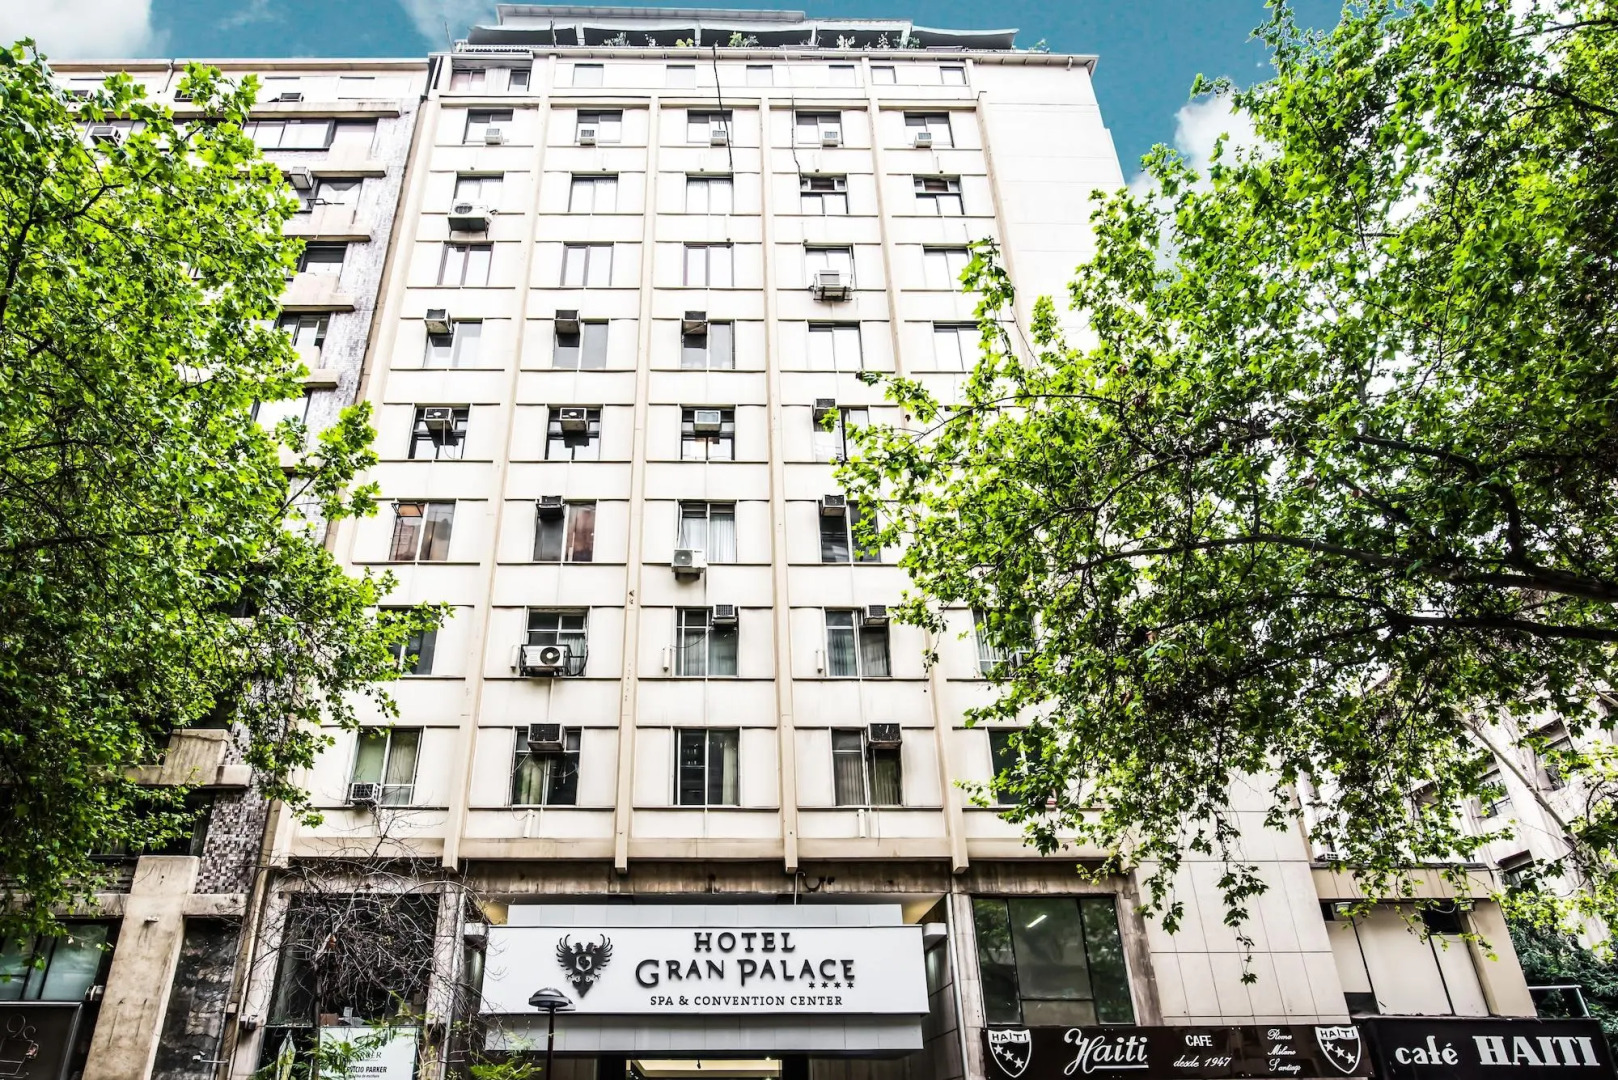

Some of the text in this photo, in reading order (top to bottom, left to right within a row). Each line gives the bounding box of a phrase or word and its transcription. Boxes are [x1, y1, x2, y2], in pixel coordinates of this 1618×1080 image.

[694, 932, 796, 953] HOTEL
[635, 959, 855, 989] GRAN PALACE
[650, 995, 843, 1006] SPA & CONVENTION CENTER
[991, 1033, 1028, 1042] HAITI
[1267, 1028, 1293, 1040] Roma
[1319, 1028, 1356, 1038] HAITI
[1185, 1034, 1213, 1047] CAFE
[1064, 1028, 1148, 1075] Haiti
[1267, 1043, 1296, 1056] Milano
[1395, 1035, 1600, 1066] café HAITI
[1173, 1054, 1232, 1068] desde 1947
